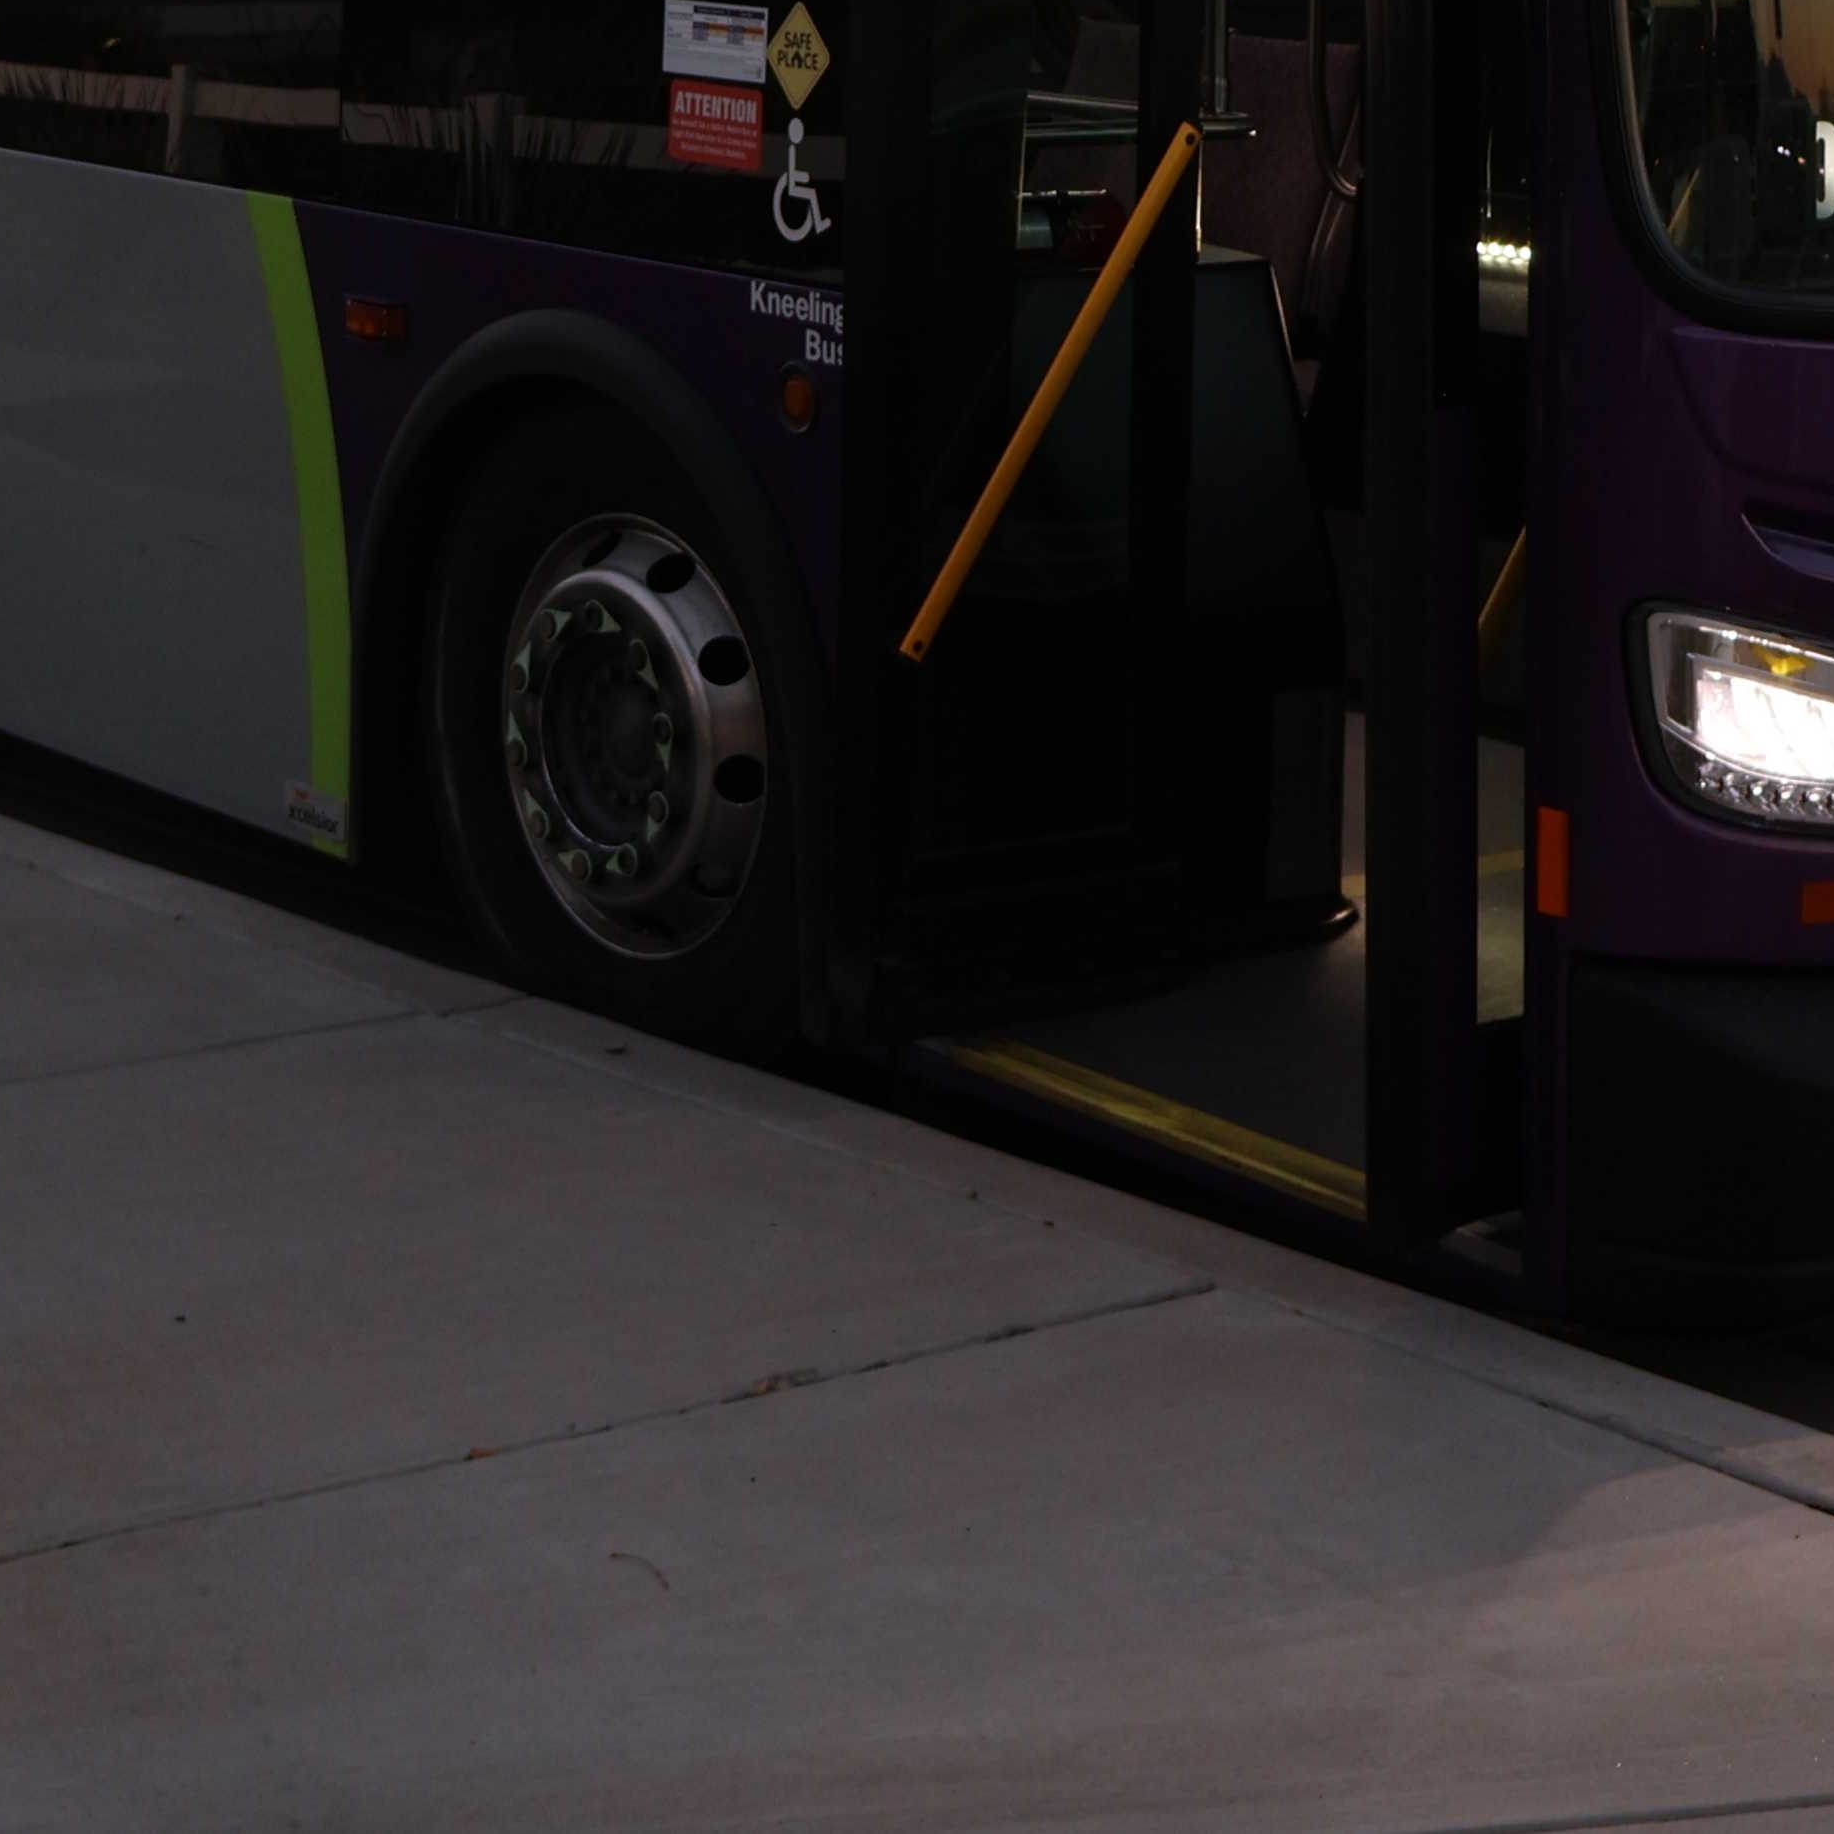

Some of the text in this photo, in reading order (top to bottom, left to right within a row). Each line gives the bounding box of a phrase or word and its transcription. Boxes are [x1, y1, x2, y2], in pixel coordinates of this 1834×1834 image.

[783, 31, 812, 51] SAFE
[674, 89, 758, 124] ATTENTION
[750, 279, 843, 335] Kneeling
